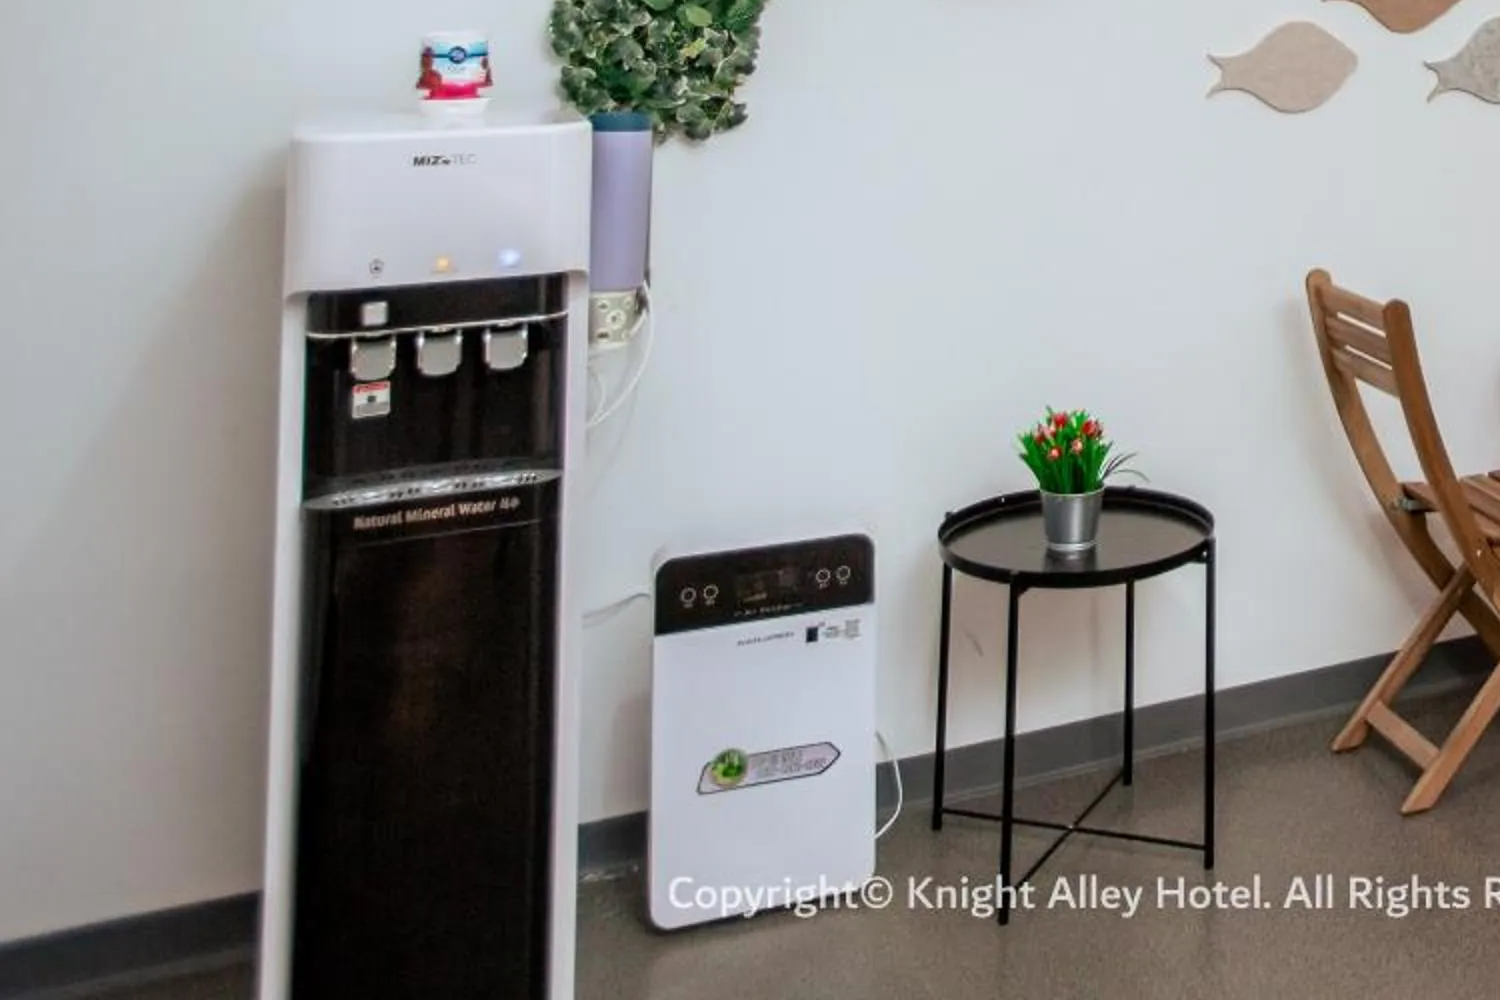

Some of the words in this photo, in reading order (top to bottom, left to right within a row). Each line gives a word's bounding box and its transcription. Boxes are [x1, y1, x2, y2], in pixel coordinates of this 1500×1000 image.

[353, 512, 403, 531] Natural
[405, 504, 456, 523] Mineral
[457, 500, 497, 516] Water
